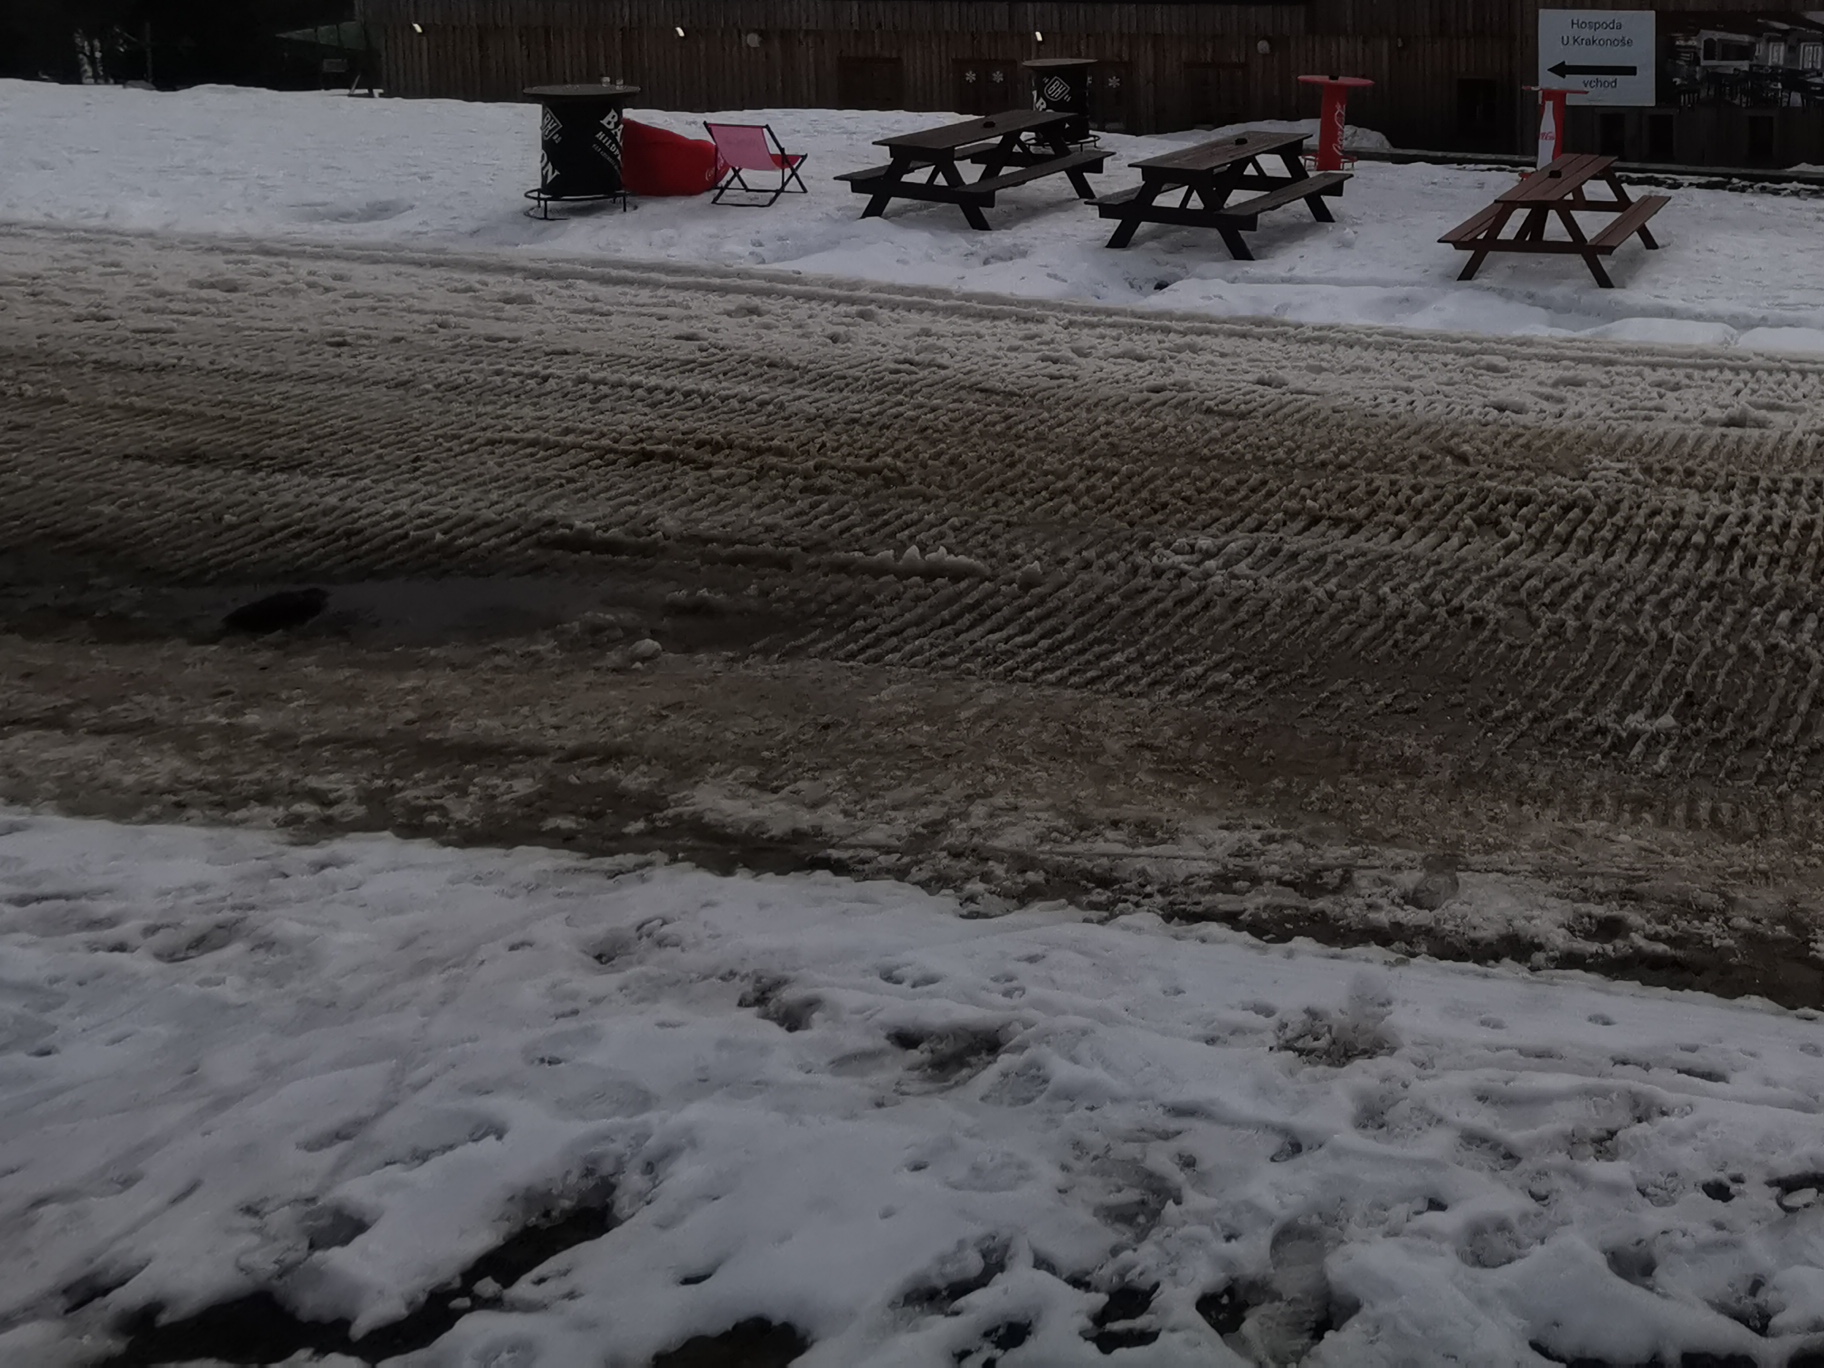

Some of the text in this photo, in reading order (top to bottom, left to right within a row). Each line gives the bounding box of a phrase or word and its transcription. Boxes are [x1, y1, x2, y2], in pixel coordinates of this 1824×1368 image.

[1570, 18, 1623, 32] Hospoda
[1561, 35, 1634, 48] U Krakonoše
[1582, 77, 1618, 89] vchod
